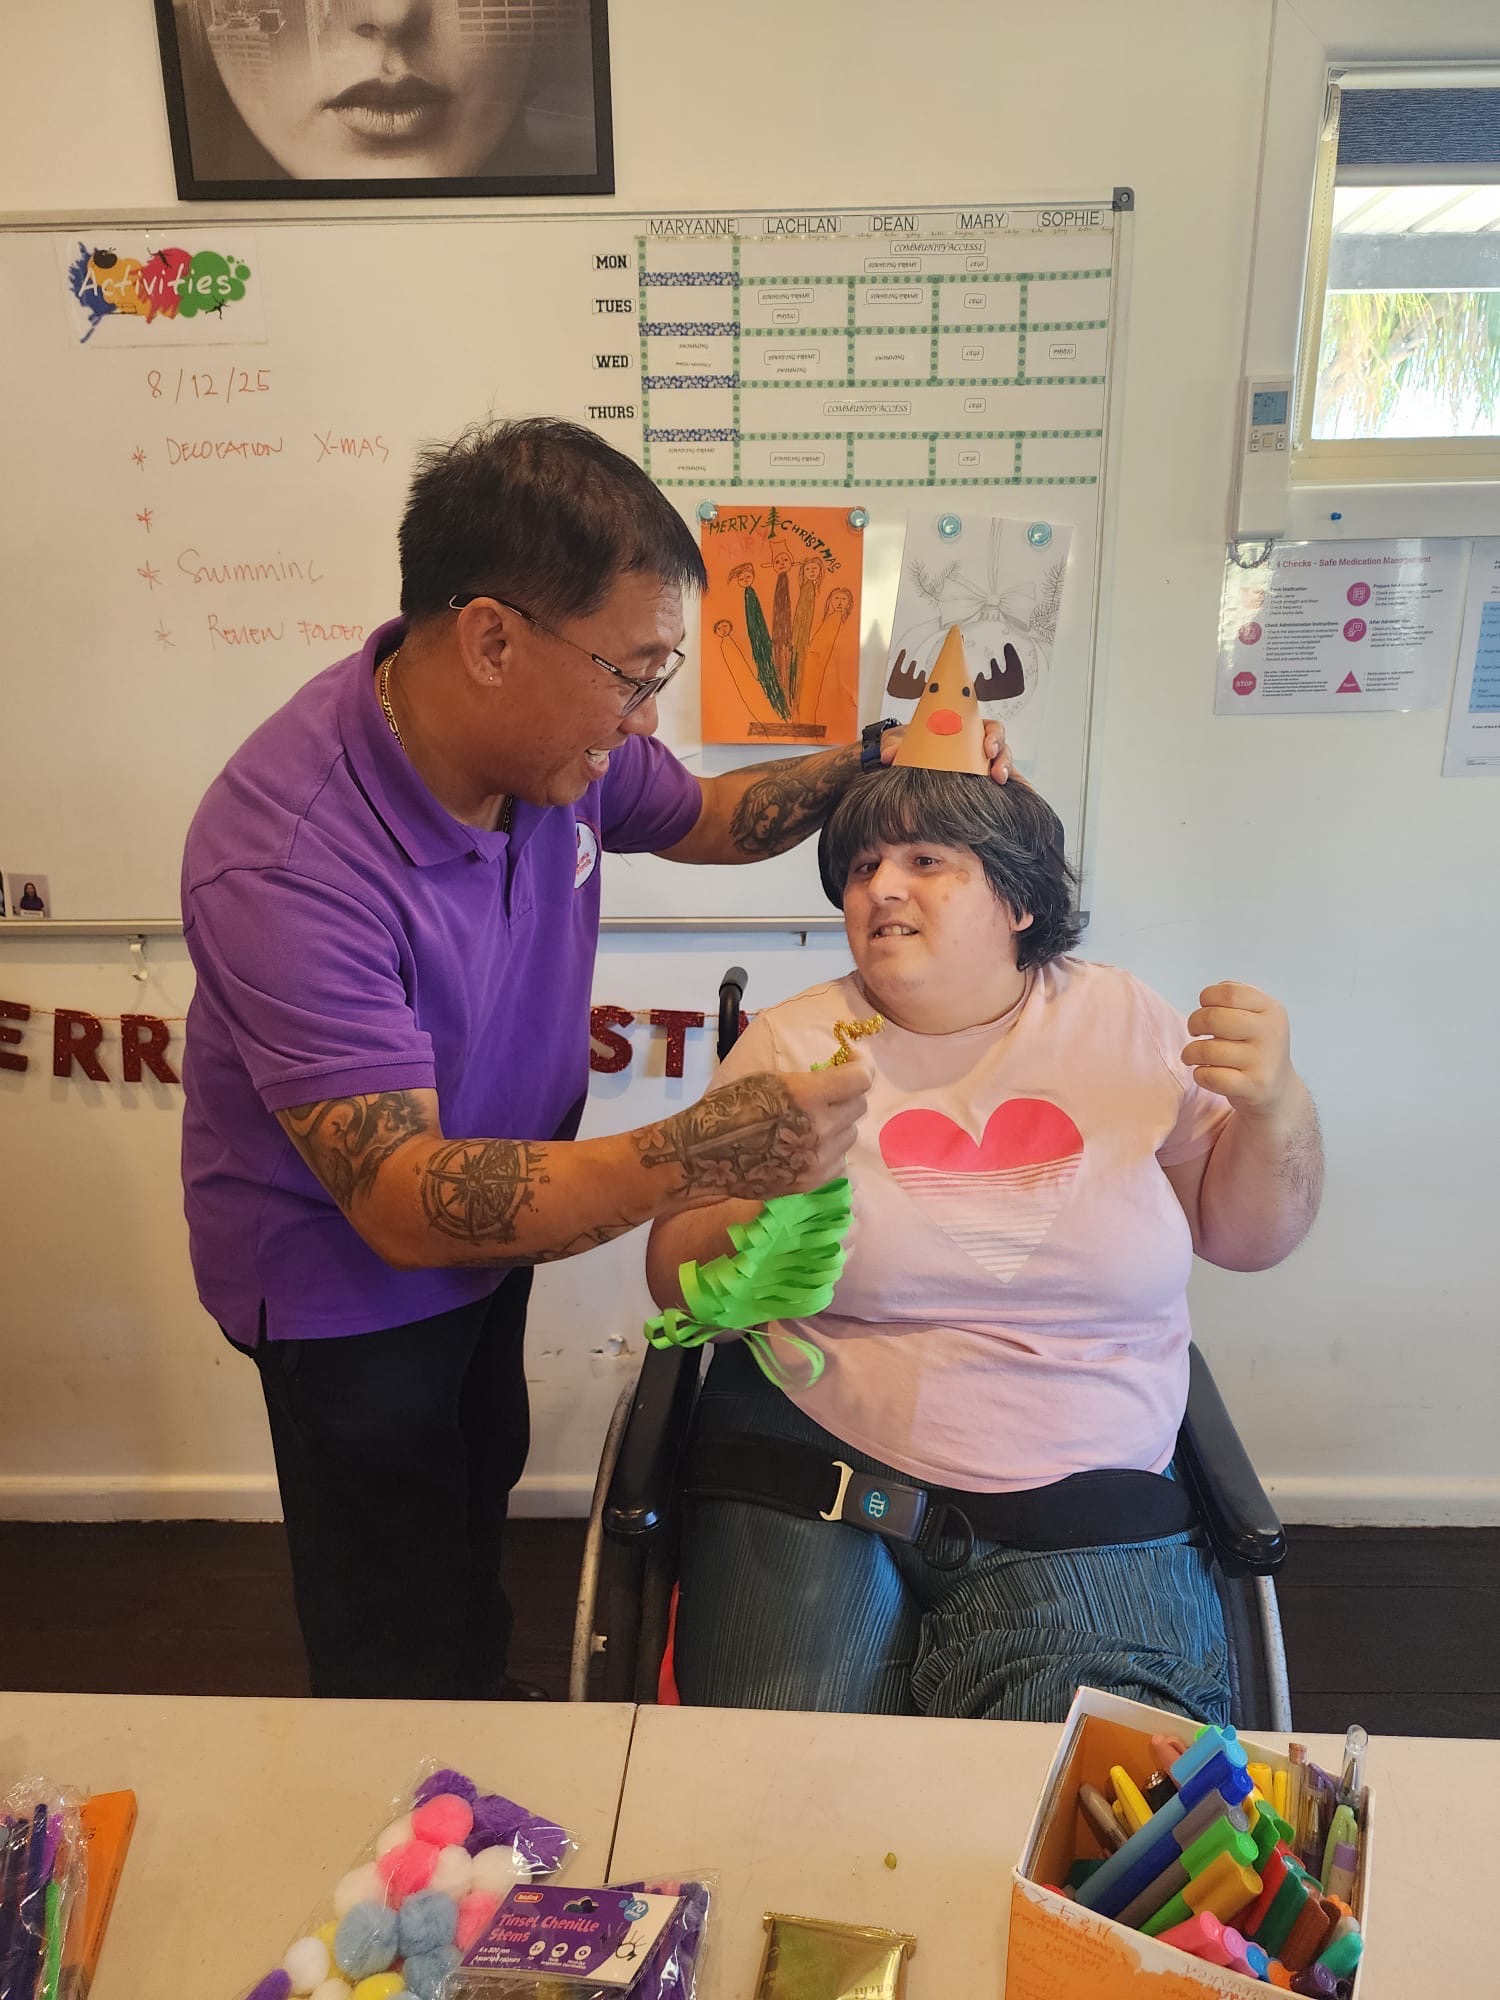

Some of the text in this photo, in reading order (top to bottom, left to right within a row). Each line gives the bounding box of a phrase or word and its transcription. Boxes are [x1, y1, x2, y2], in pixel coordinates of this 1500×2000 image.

[767, 218, 837, 233] LACHLAN
[873, 216, 914, 231] DEAN
[961, 213, 1005, 229] MARY
[1041, 211, 1100, 226] SOPHIE
[650, 219, 735, 234] MARYANNE
[595, 255, 628, 269] MON
[78, 263, 232, 297] Activities
[596, 299, 632, 313] TUES
[596, 355, 629, 368] WED
[588, 405, 635, 419] THURS
[709, 515, 762, 536] MERRY
[1282, 559, 1312, 569] Checks
[1319, 558, 1337, 567] Safe
[1338, 557, 1382, 567] Medication
[500, 1912, 600, 1934] Tinsel Chenille
[488, 1928, 531, 1943] Stems
